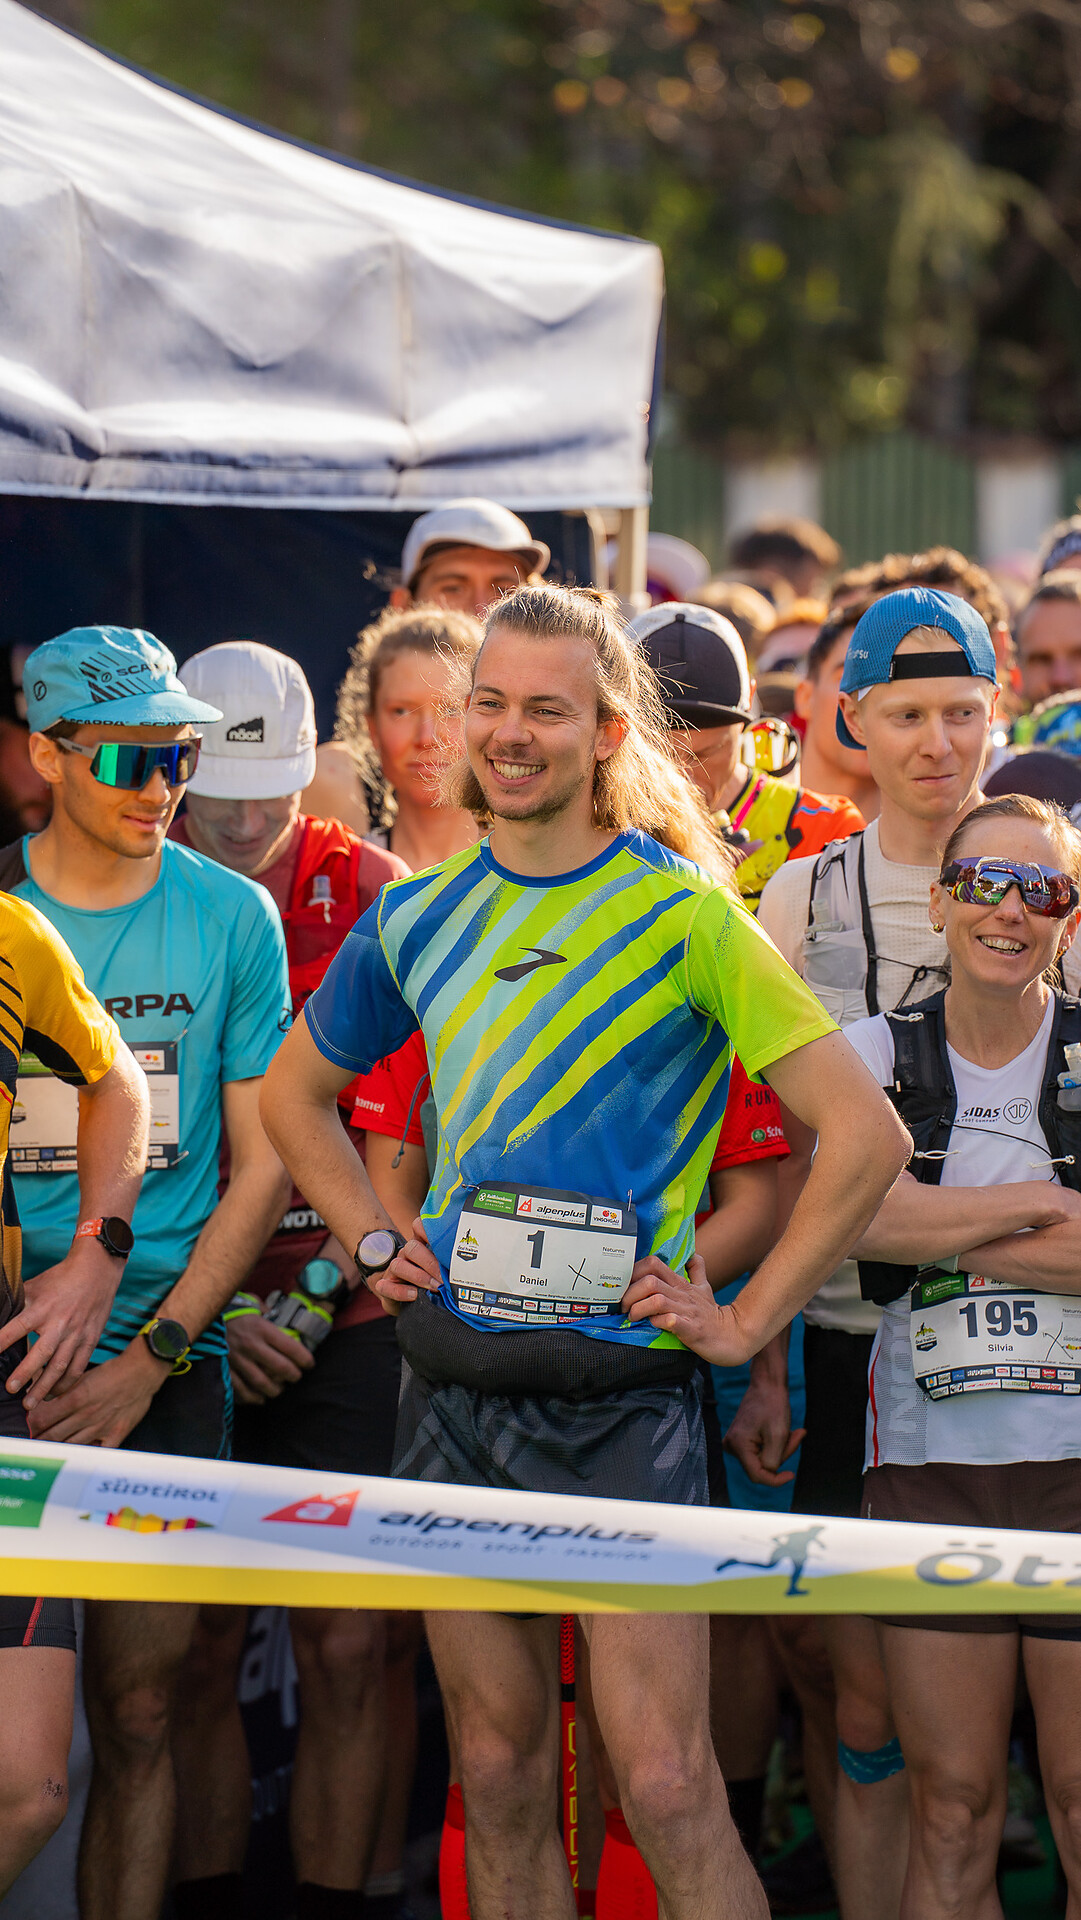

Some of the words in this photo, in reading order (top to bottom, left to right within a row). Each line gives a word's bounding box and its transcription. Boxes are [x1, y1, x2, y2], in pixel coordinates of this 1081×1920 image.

[961, 1107, 1001, 1118] SIDAS
[537, 1206, 585, 1218] alpenplus
[527, 1230, 545, 1269] 1
[520, 1275, 548, 1286] Daniel
[959, 1300, 1038, 1338] 195
[988, 1343, 1014, 1352] Silvia
[379, 1509, 658, 1544] alpenplus
